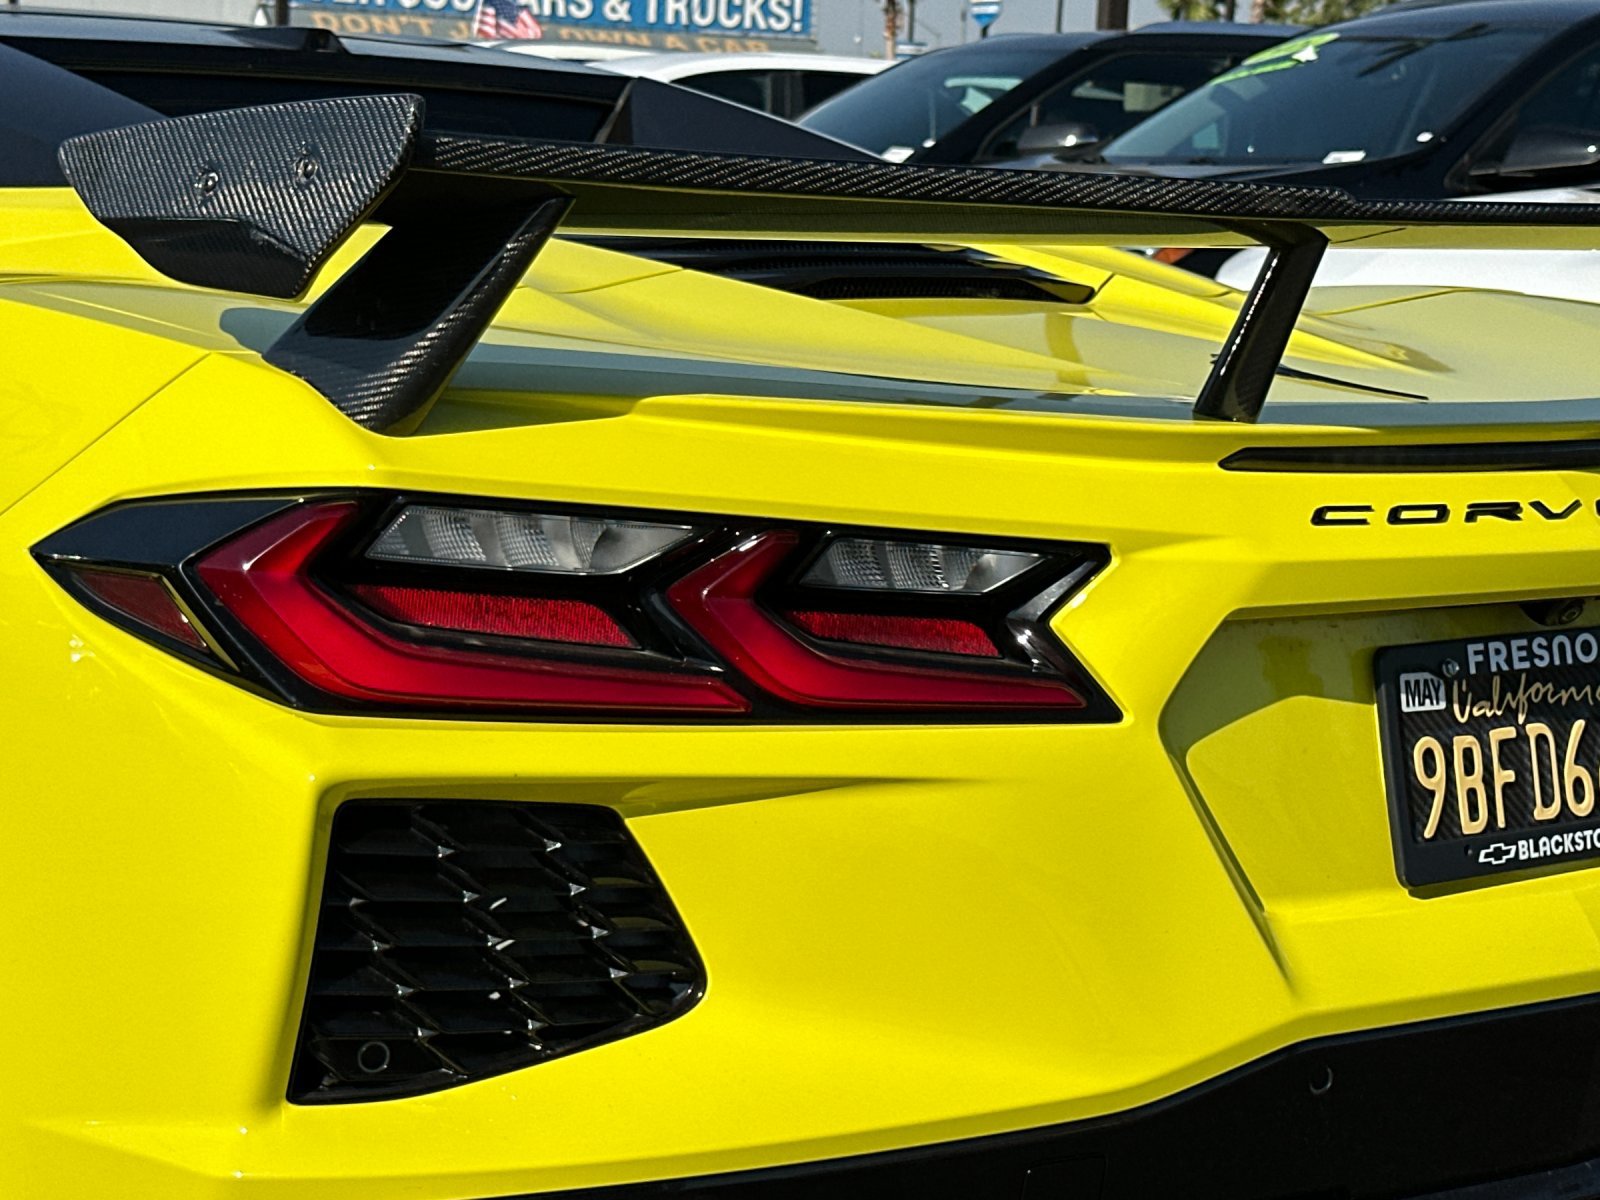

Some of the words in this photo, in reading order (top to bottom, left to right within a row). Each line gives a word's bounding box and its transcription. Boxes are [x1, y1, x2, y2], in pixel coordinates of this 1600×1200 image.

[311, 11, 433, 36] DON'T
[602, 0, 632, 22] &
[646, 0, 803, 32] TRUCKS!
[1310, 498, 1600, 526] CORV
[1467, 632, 1599, 675] FRESNO
[1404, 678, 1442, 708] MAY
[1452, 672, 1600, 723] Californi
[1413, 719, 1600, 839] 9BFD6
